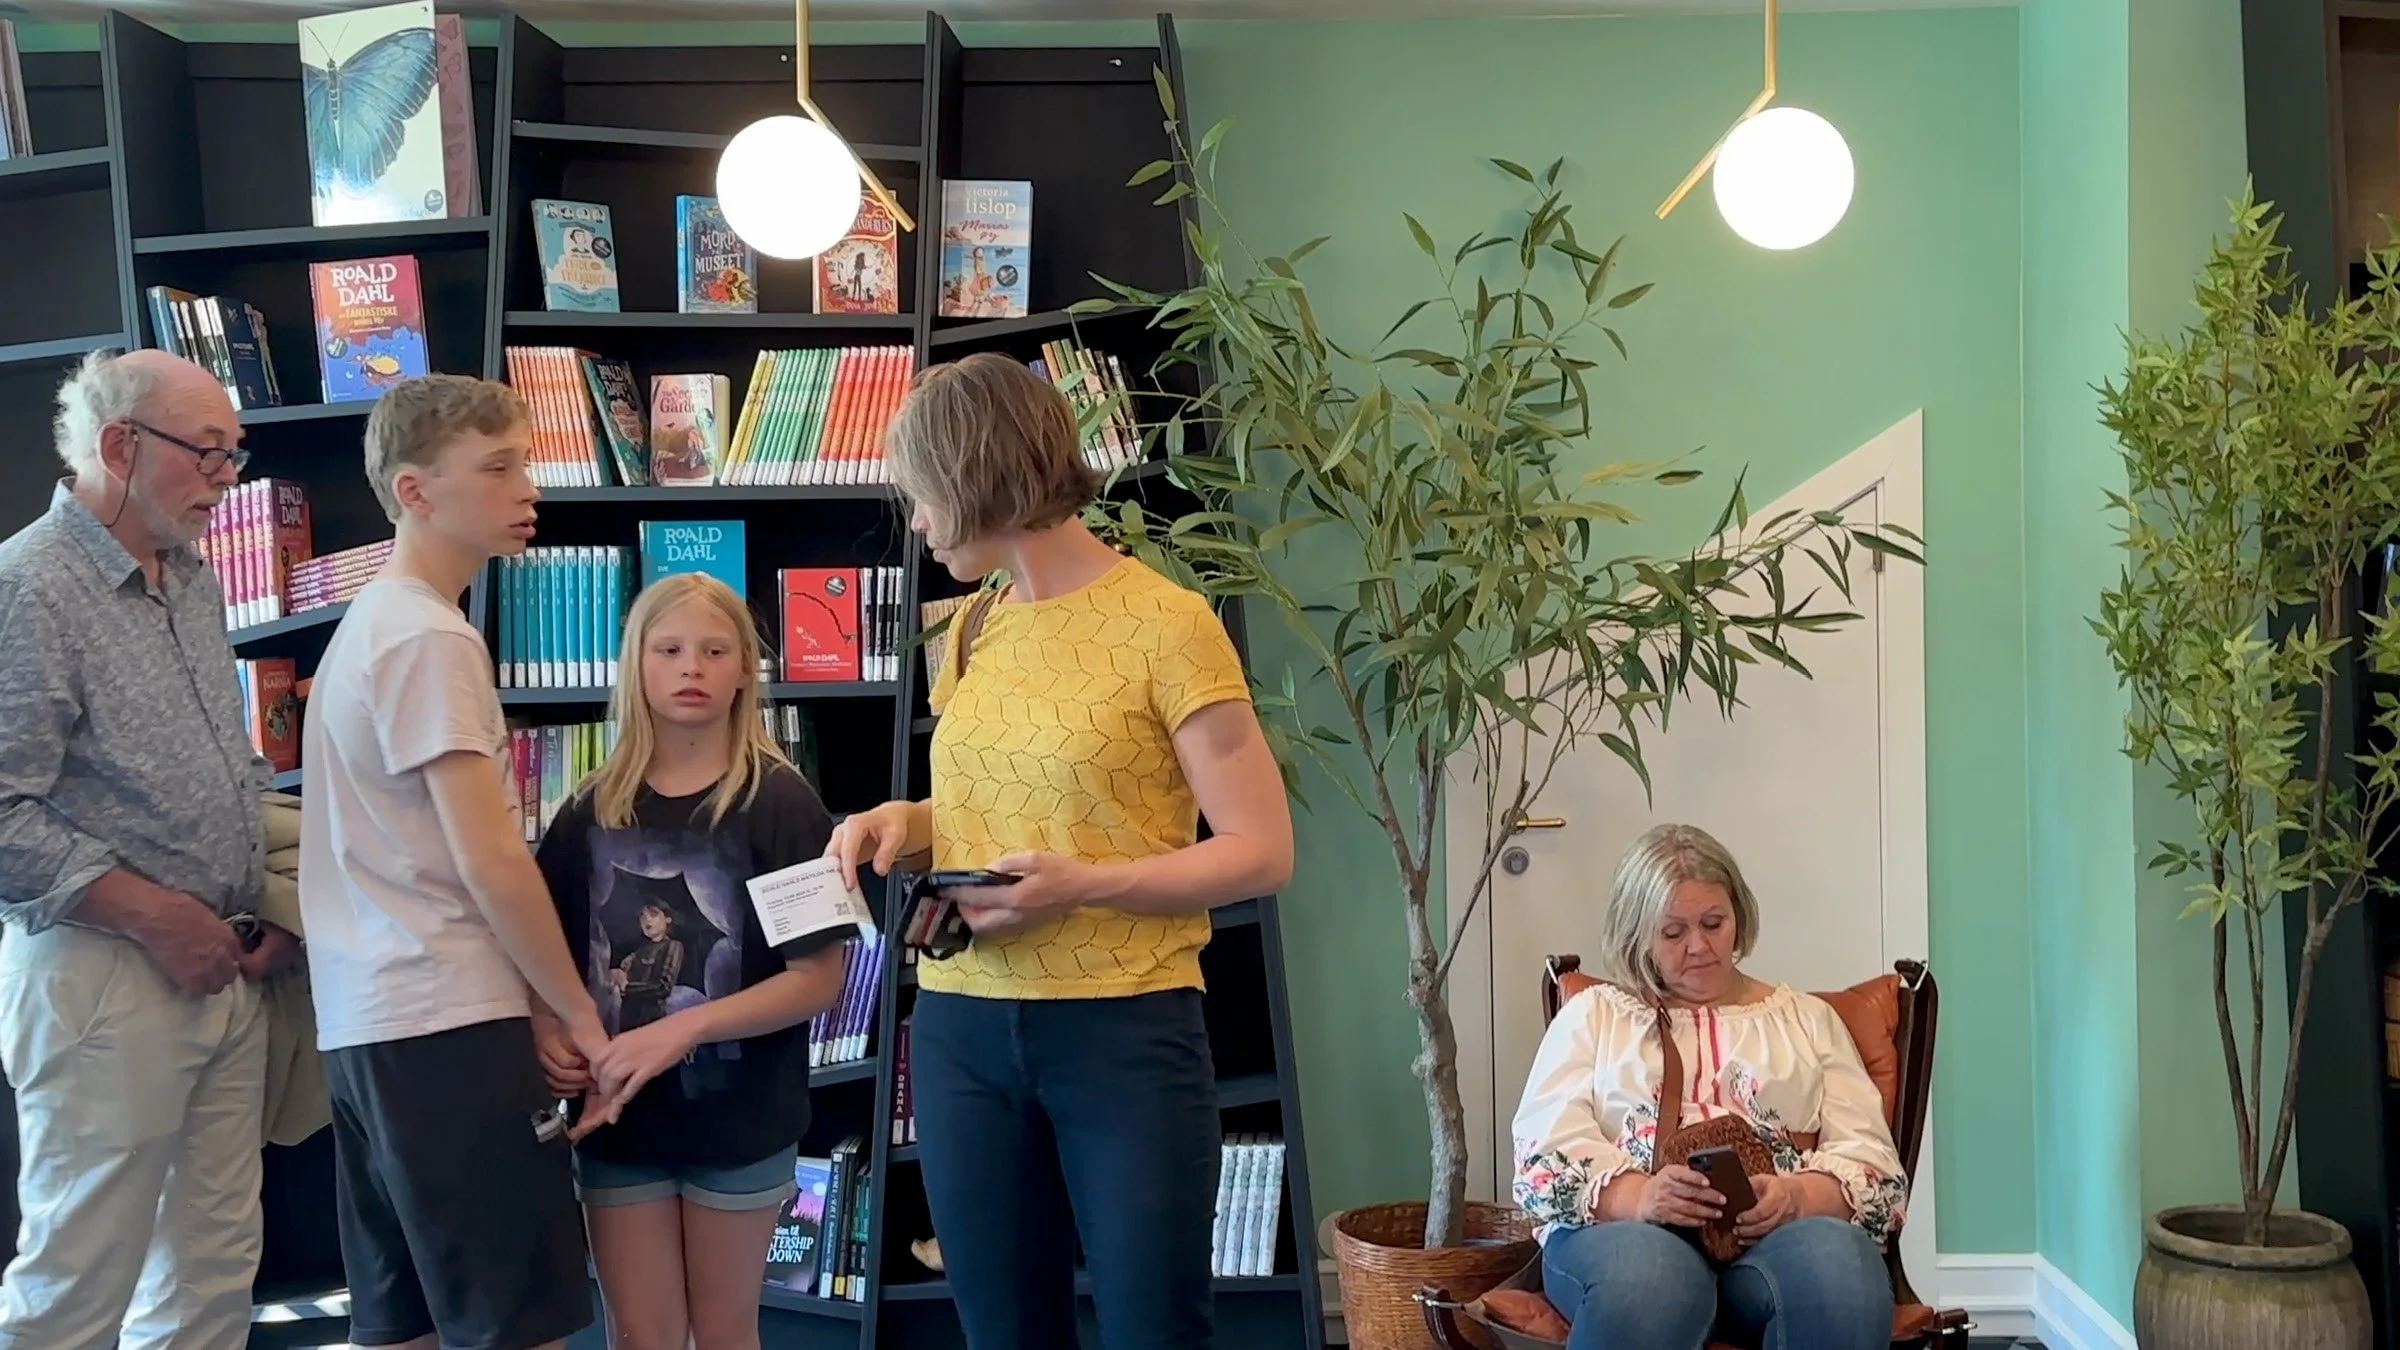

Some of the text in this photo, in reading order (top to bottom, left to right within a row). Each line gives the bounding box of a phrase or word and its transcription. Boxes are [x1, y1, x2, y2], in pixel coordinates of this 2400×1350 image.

[964, 186, 1009, 197] Victoria
[700, 230, 735, 251] MORD
[695, 253, 744, 274] MUSEET
[331, 263, 397, 287] ROALD
[337, 284, 395, 306] DAHL
[660, 397, 702, 414] Garde
[664, 526, 723, 545] ROALD
[667, 544, 717, 561] DAHL
[896, 1074, 905, 1113] DRAMA
[770, 1236, 814, 1250] TERSHIP
[766, 1248, 804, 1263] DOWN
